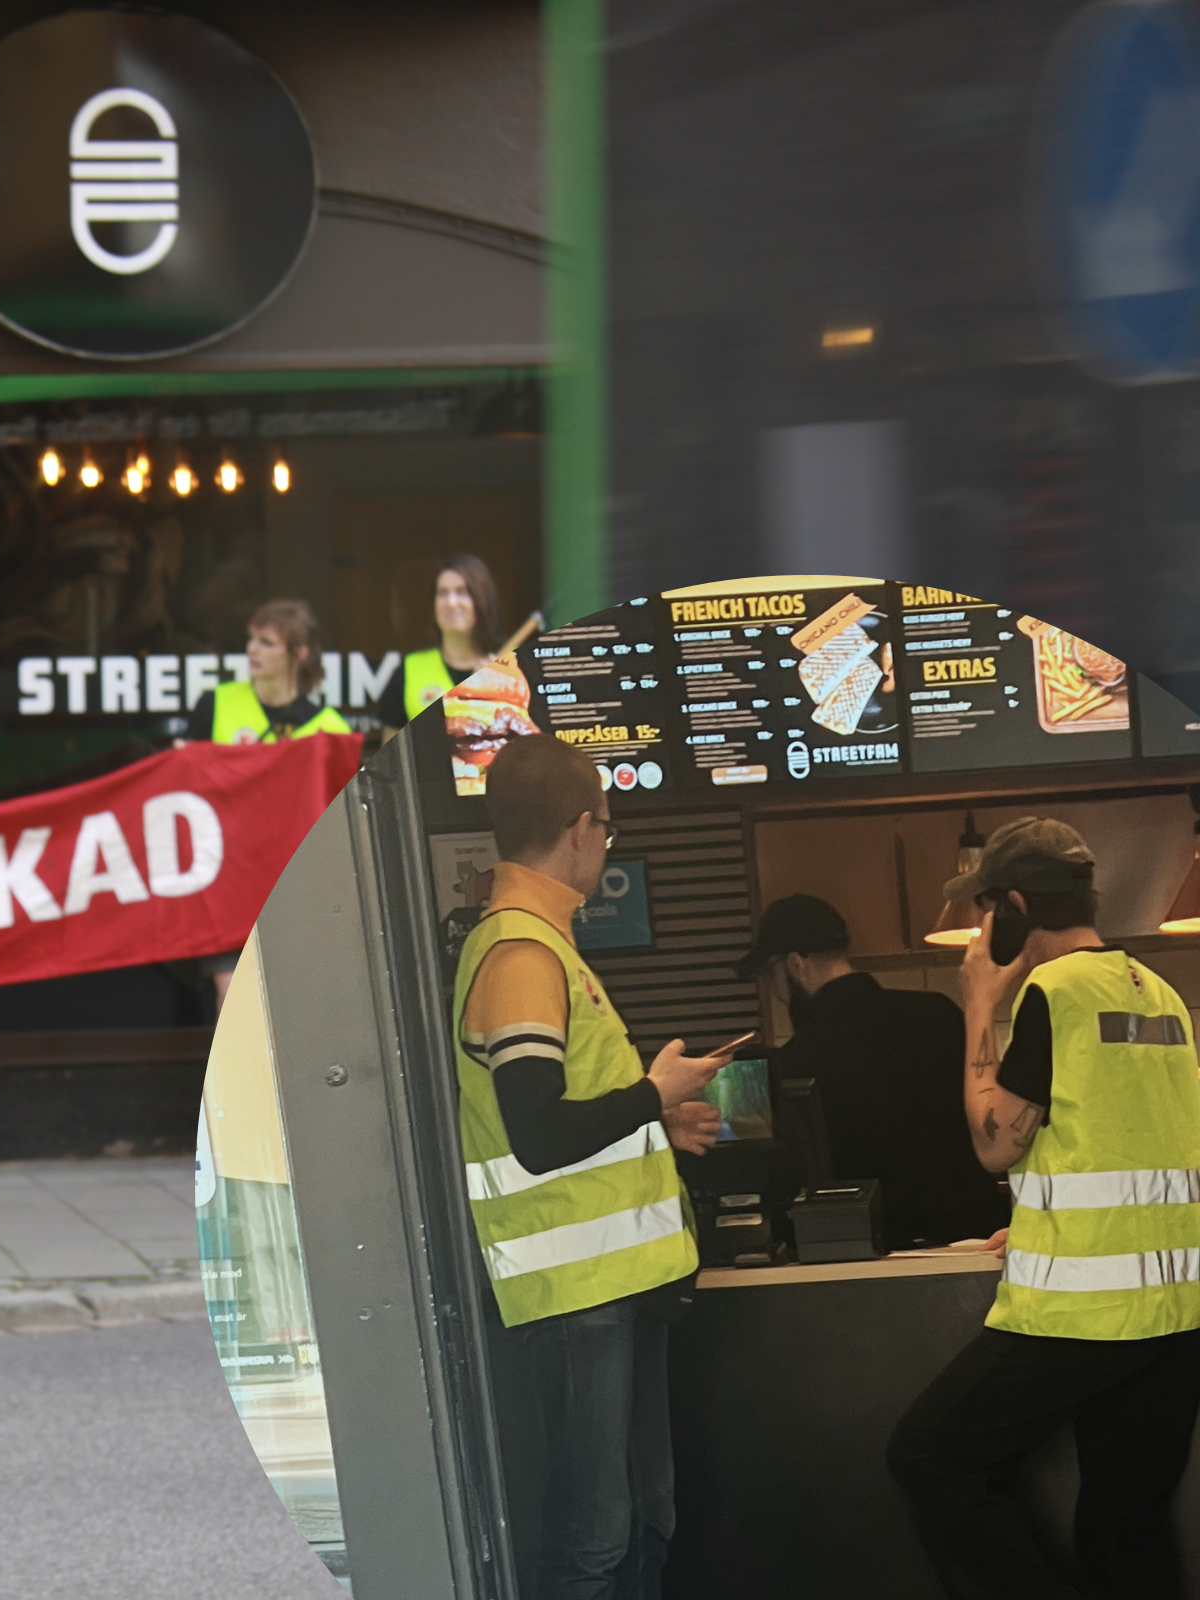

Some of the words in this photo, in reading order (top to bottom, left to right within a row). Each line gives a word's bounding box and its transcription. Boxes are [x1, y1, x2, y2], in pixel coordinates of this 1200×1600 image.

[671, 598, 744, 622] FRENCH
[746, 594, 806, 617] TACOS
[923, 657, 997, 681] EXTRAS
[812, 742, 899, 763] STREETFAM
